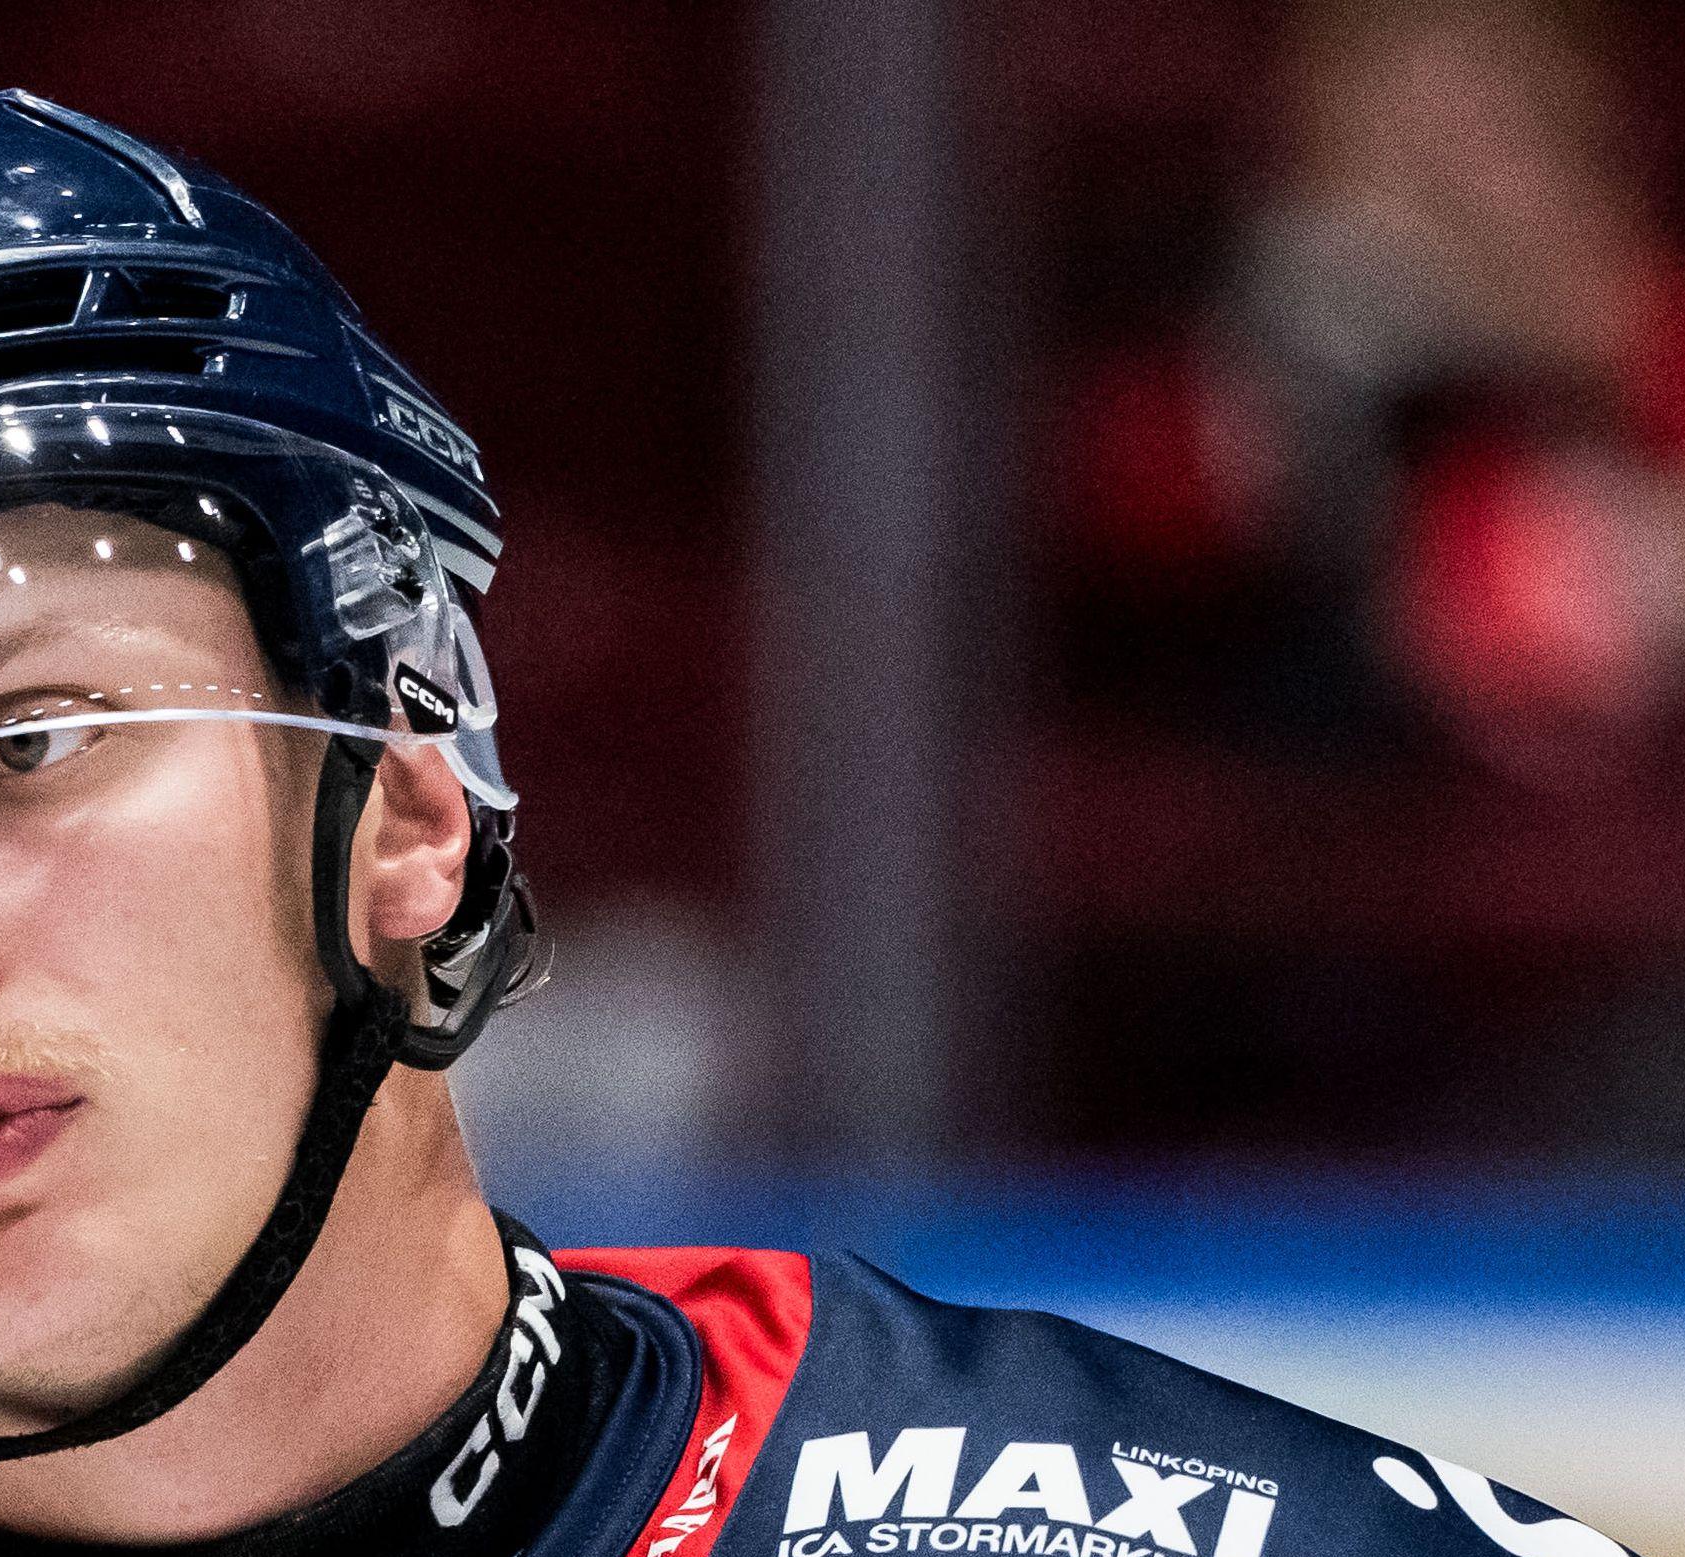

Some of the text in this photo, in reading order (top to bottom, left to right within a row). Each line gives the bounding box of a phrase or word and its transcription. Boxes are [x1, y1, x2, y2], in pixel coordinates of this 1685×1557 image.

[399, 675, 455, 725] CCM
[430, 1246, 566, 1528] CCM
[1111, 1441, 1280, 1497] LINKÖPING
